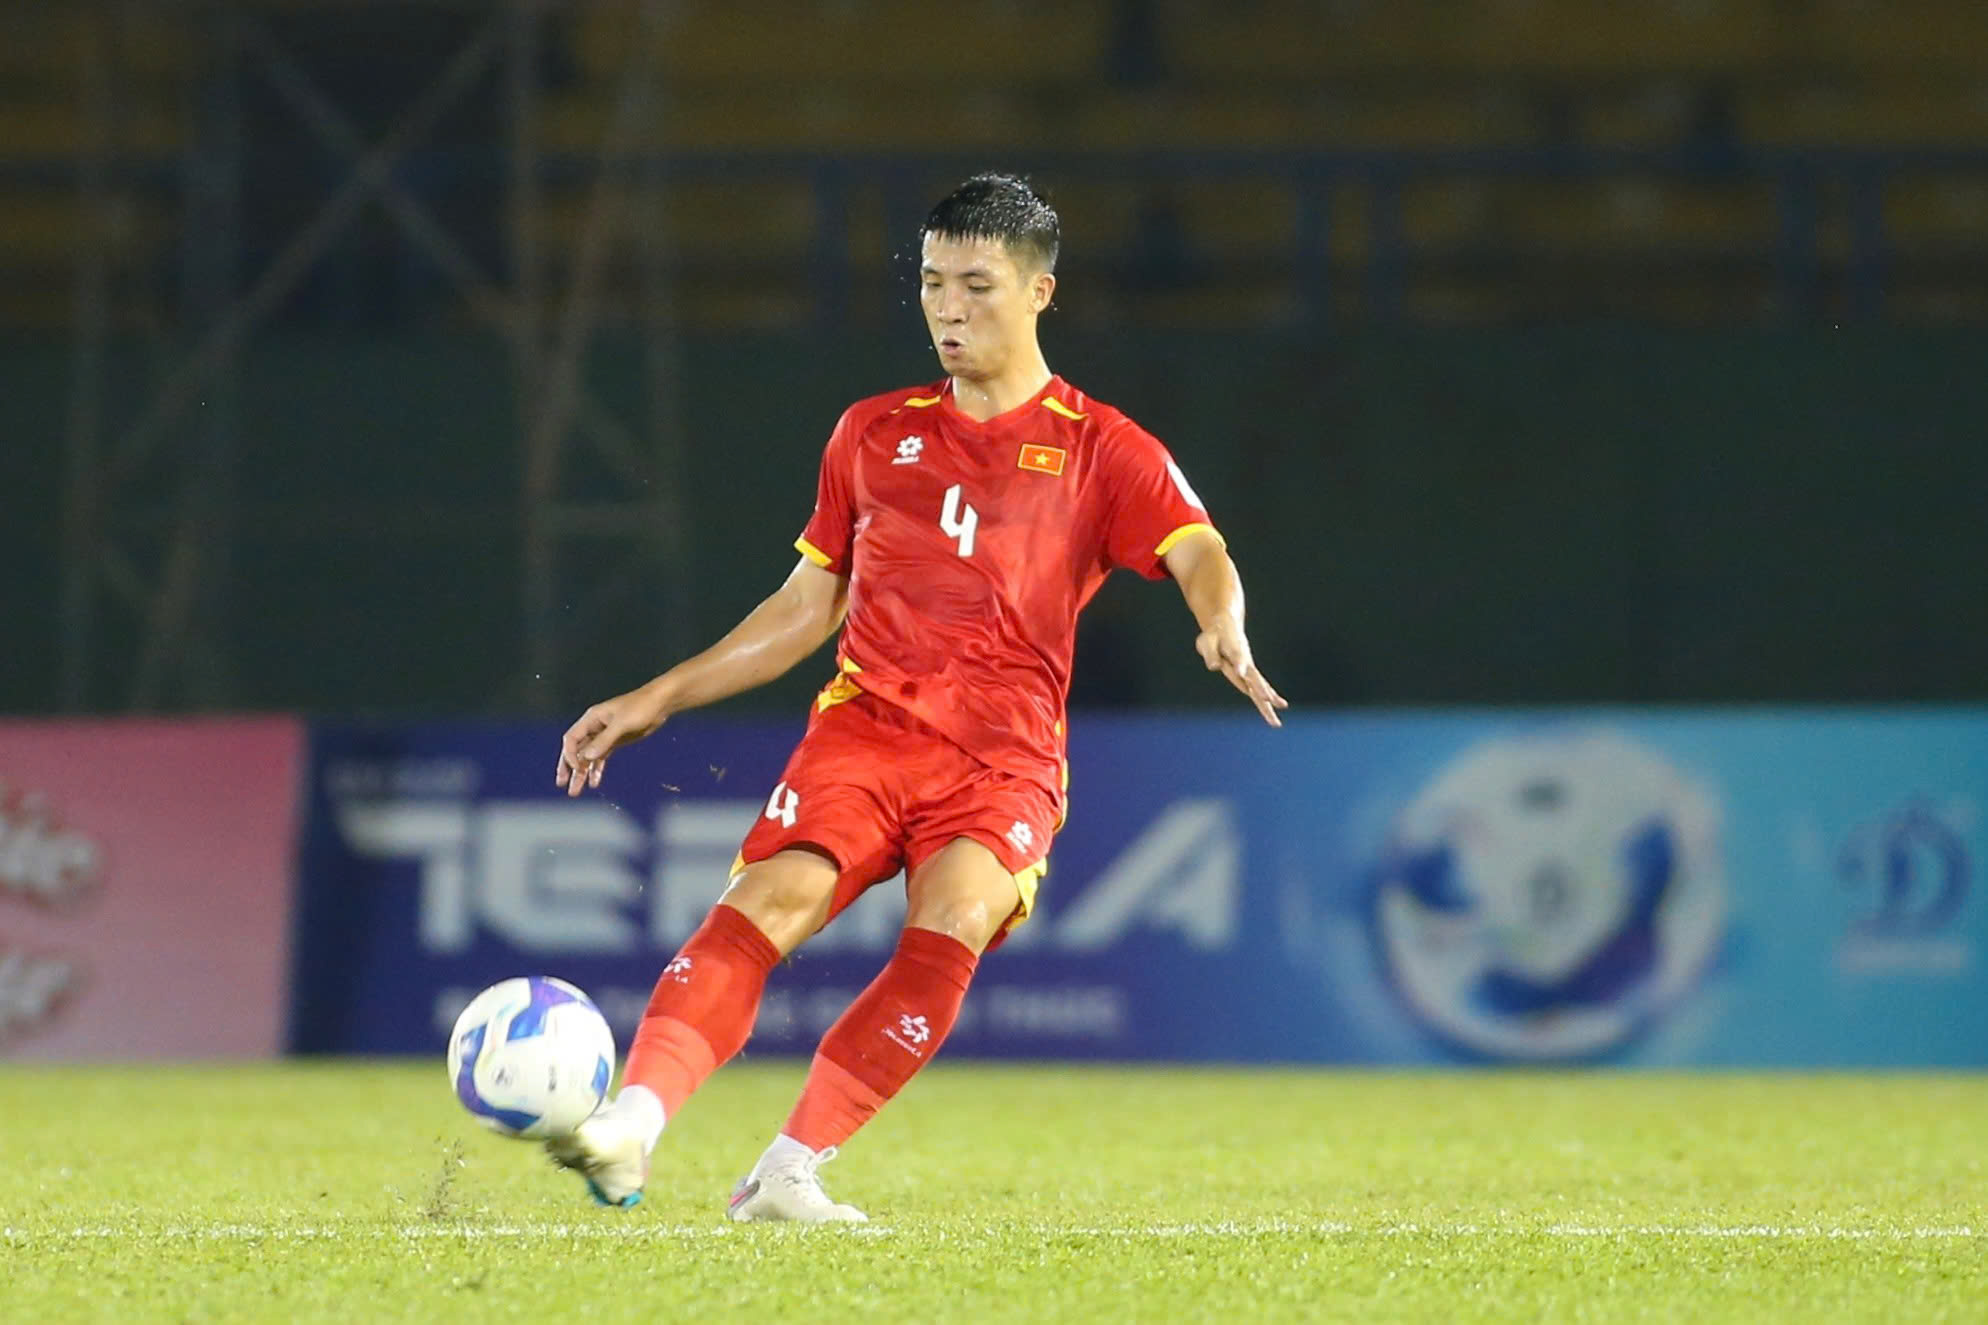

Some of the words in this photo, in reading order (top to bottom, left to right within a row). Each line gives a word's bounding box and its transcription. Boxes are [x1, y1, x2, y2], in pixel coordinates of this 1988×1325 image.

[939, 483, 979, 557] 4
[765, 780, 799, 828] 4
[338, 800, 1242, 950] TEA
